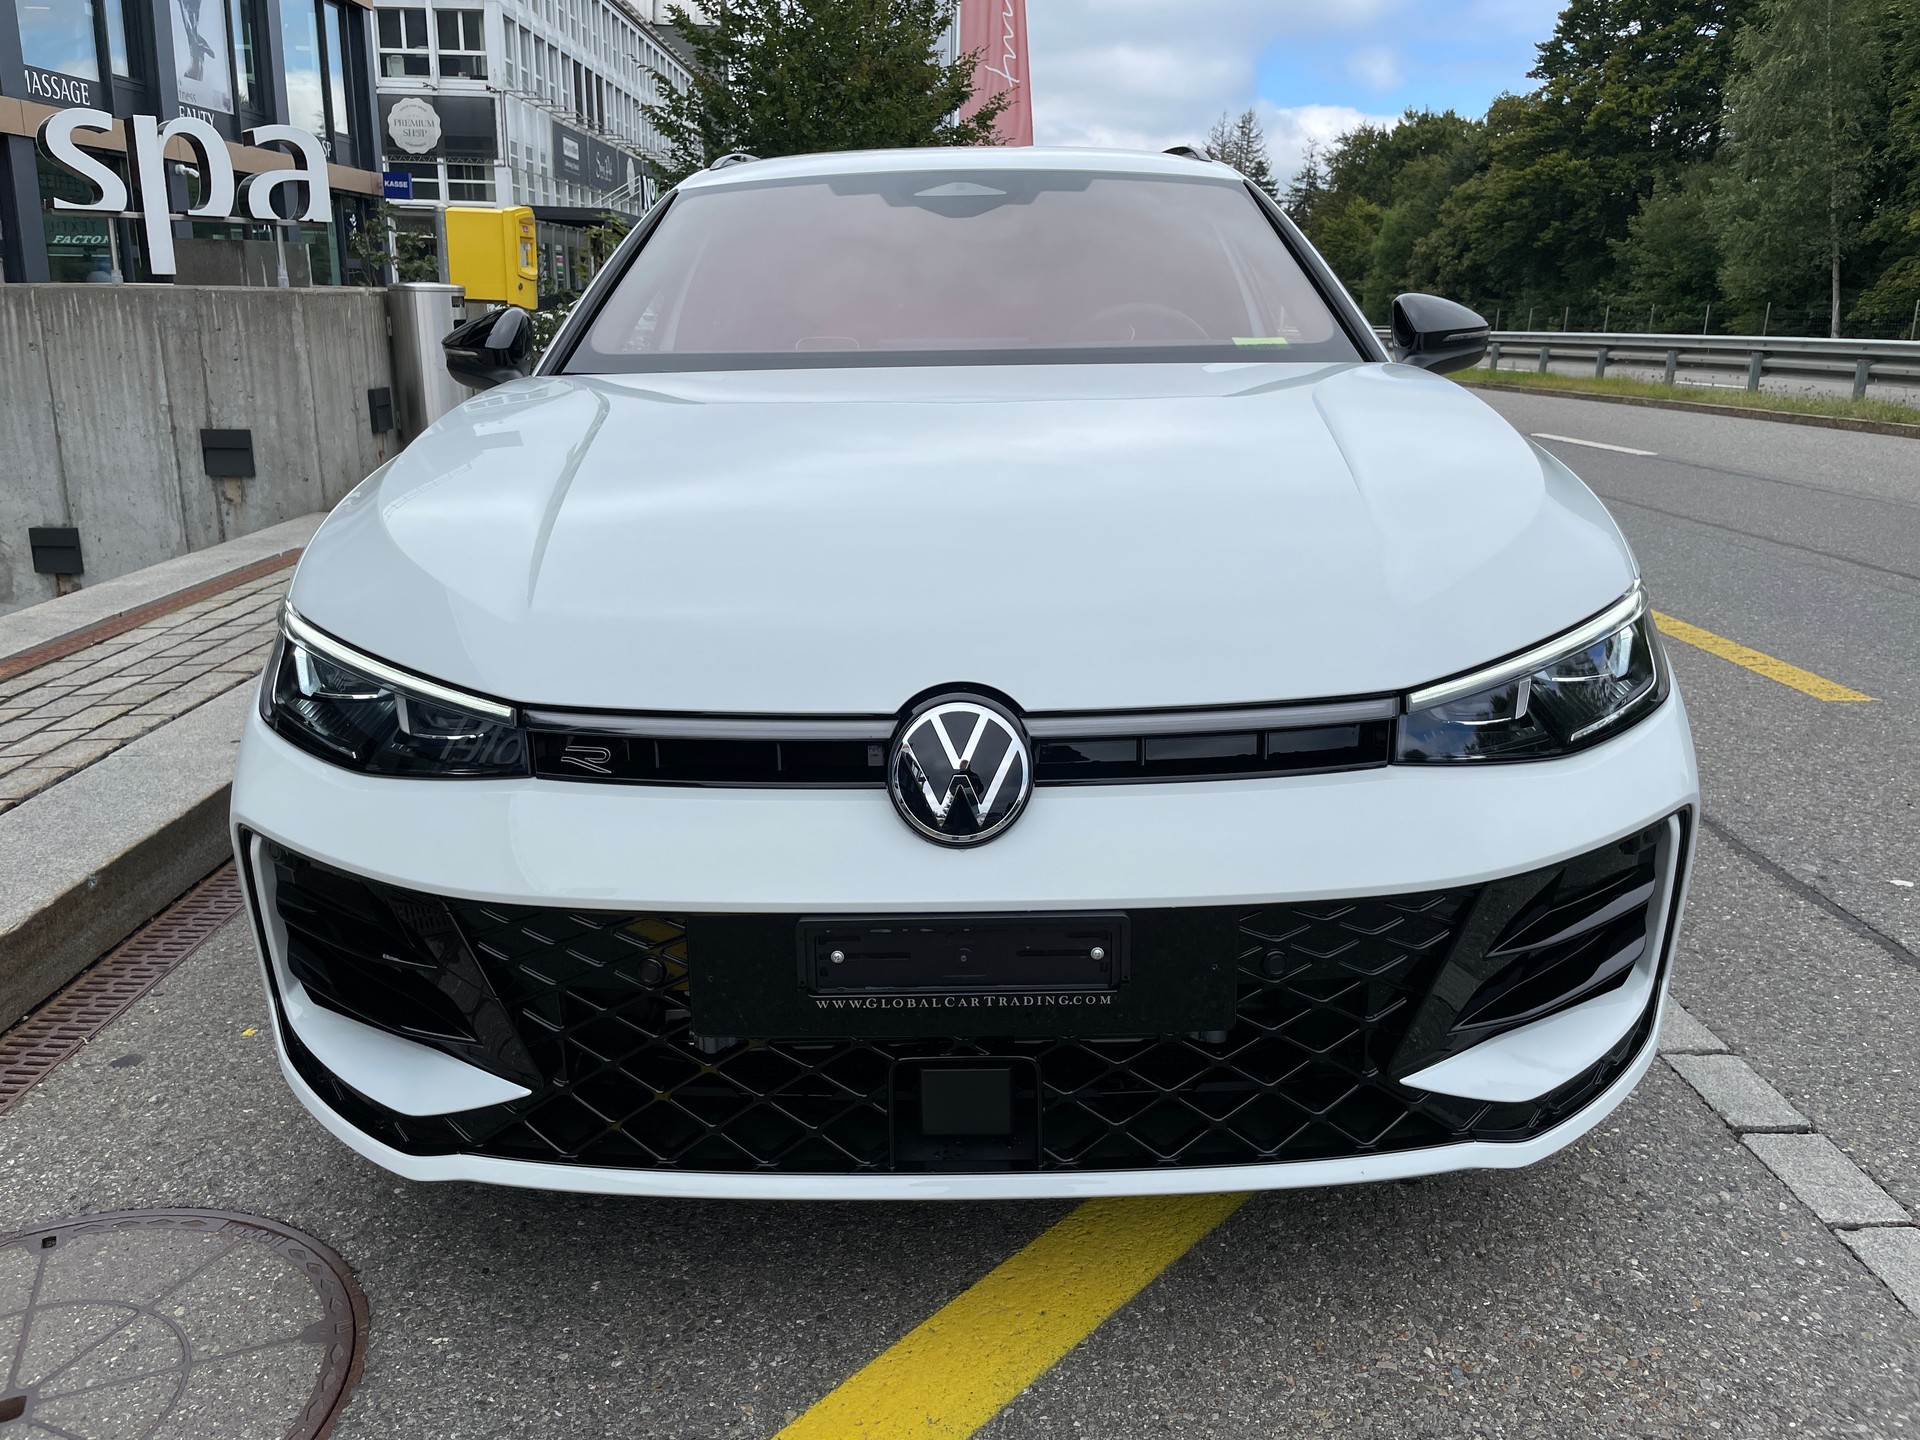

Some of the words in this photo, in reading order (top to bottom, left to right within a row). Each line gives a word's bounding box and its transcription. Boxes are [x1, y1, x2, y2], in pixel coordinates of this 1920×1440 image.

[393, 119, 435, 128] PREMIUM
[384, 180, 408, 188] KASSE
[44, 107, 332, 275] spa
